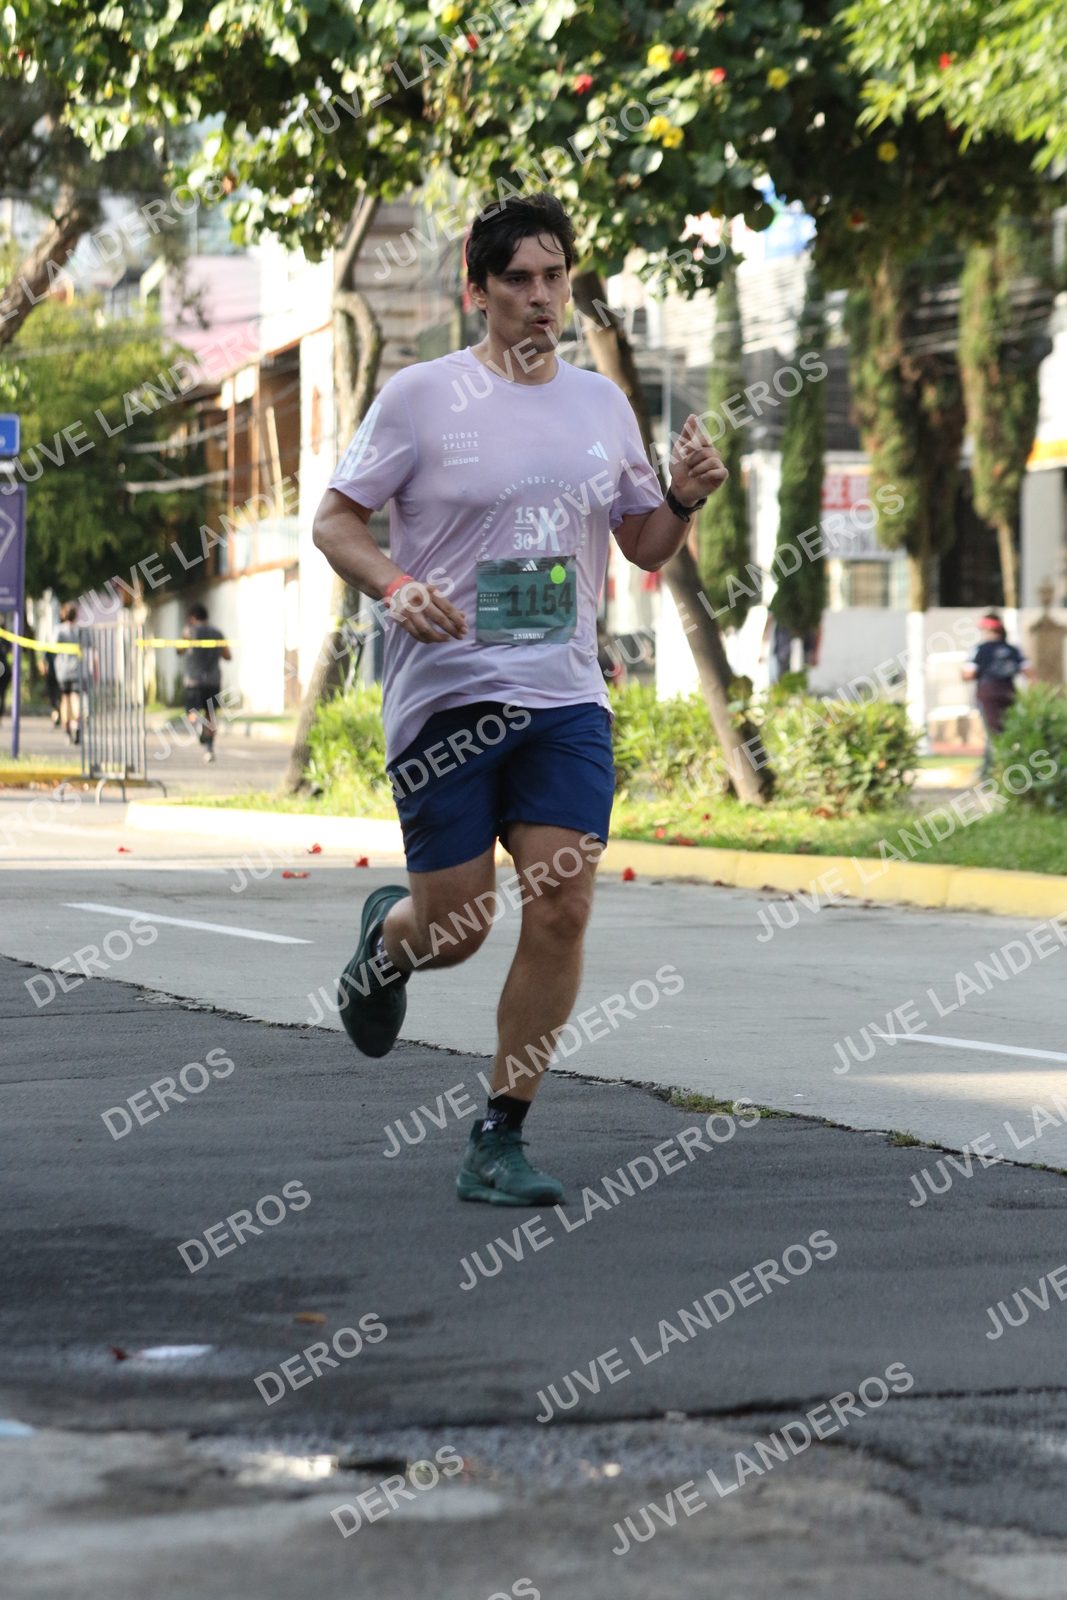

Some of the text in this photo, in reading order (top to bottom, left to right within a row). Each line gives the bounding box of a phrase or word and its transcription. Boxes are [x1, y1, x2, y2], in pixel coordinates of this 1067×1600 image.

[442, 431, 479, 441] ADIDAS
[515, 506, 534, 524] 15
[506, 583, 573, 616] 1154
